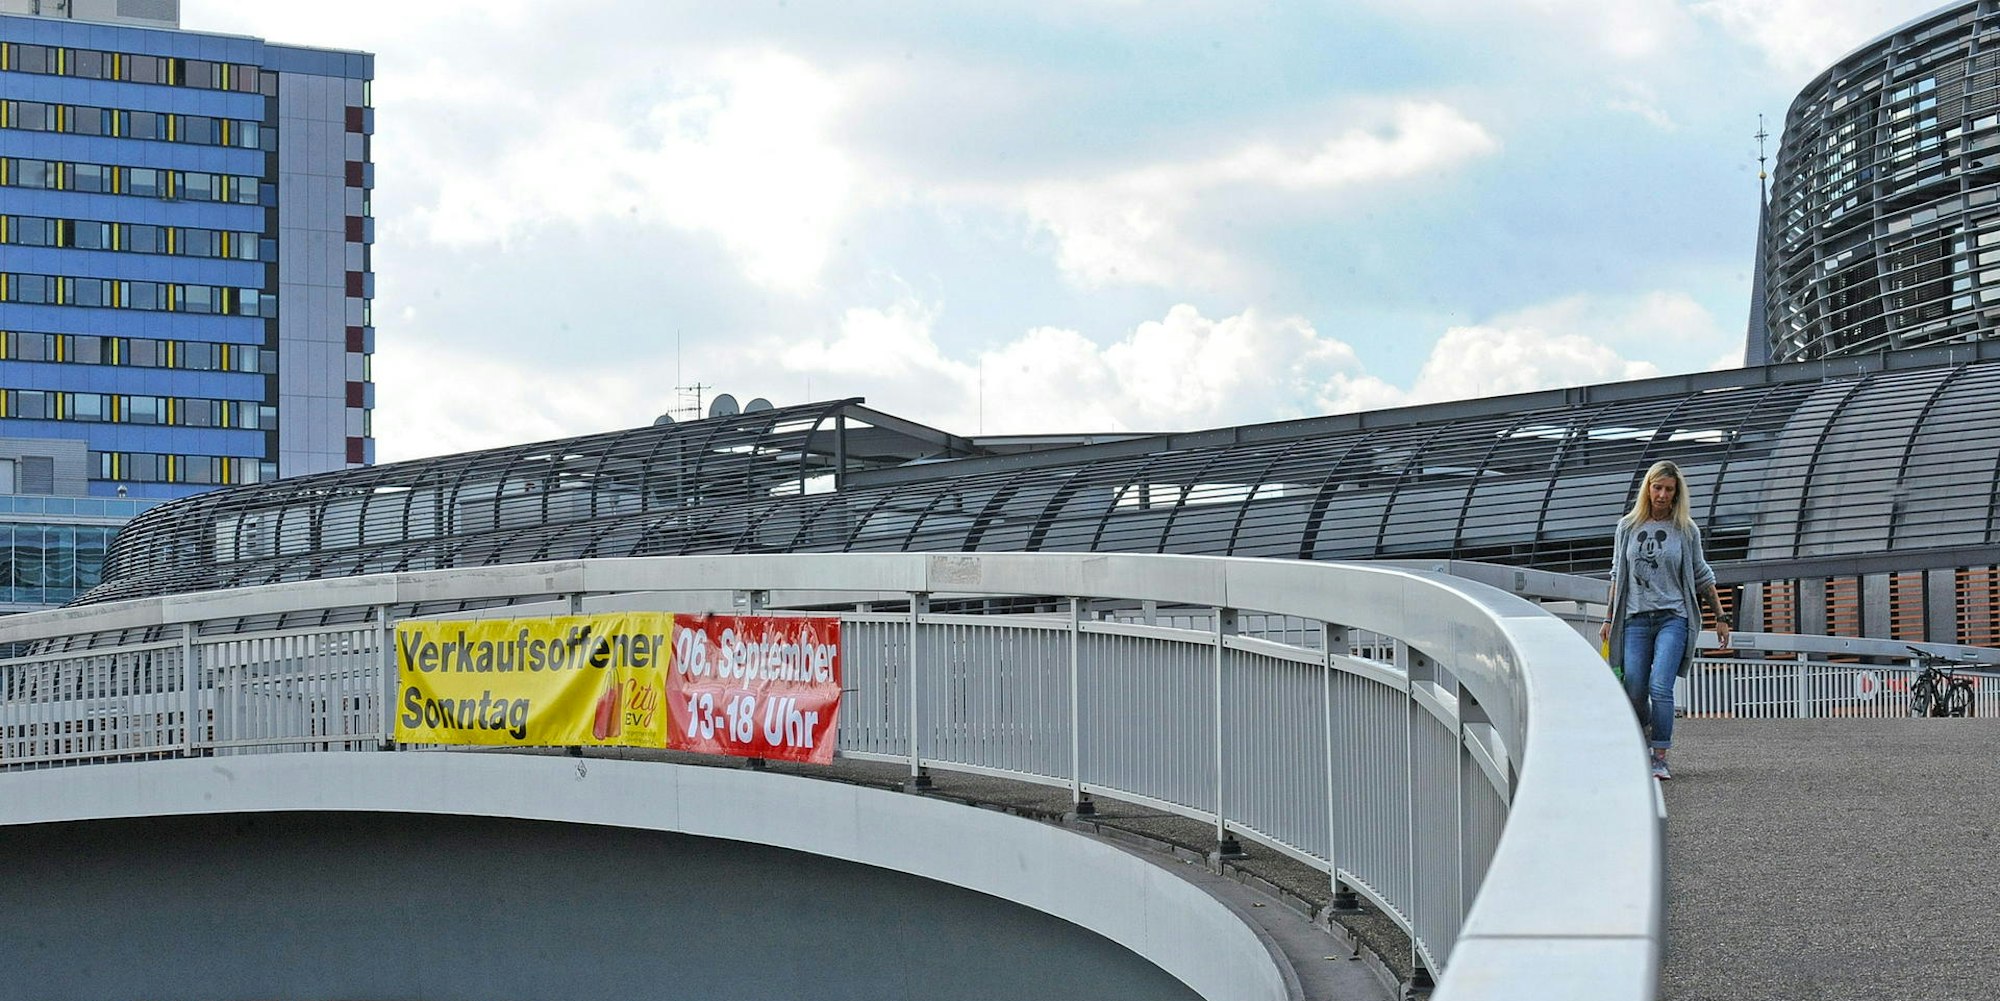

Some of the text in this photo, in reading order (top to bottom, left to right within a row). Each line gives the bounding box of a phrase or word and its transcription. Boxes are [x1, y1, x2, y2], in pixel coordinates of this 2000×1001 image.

[400, 626, 664, 672] Verkaufsoffener
[677, 627, 837, 692] 06. September
[401, 685, 530, 740] Sonntag
[624, 678, 657, 728] City
[625, 712, 643, 726] EV
[688, 691, 818, 748] 13-18 Uhr
